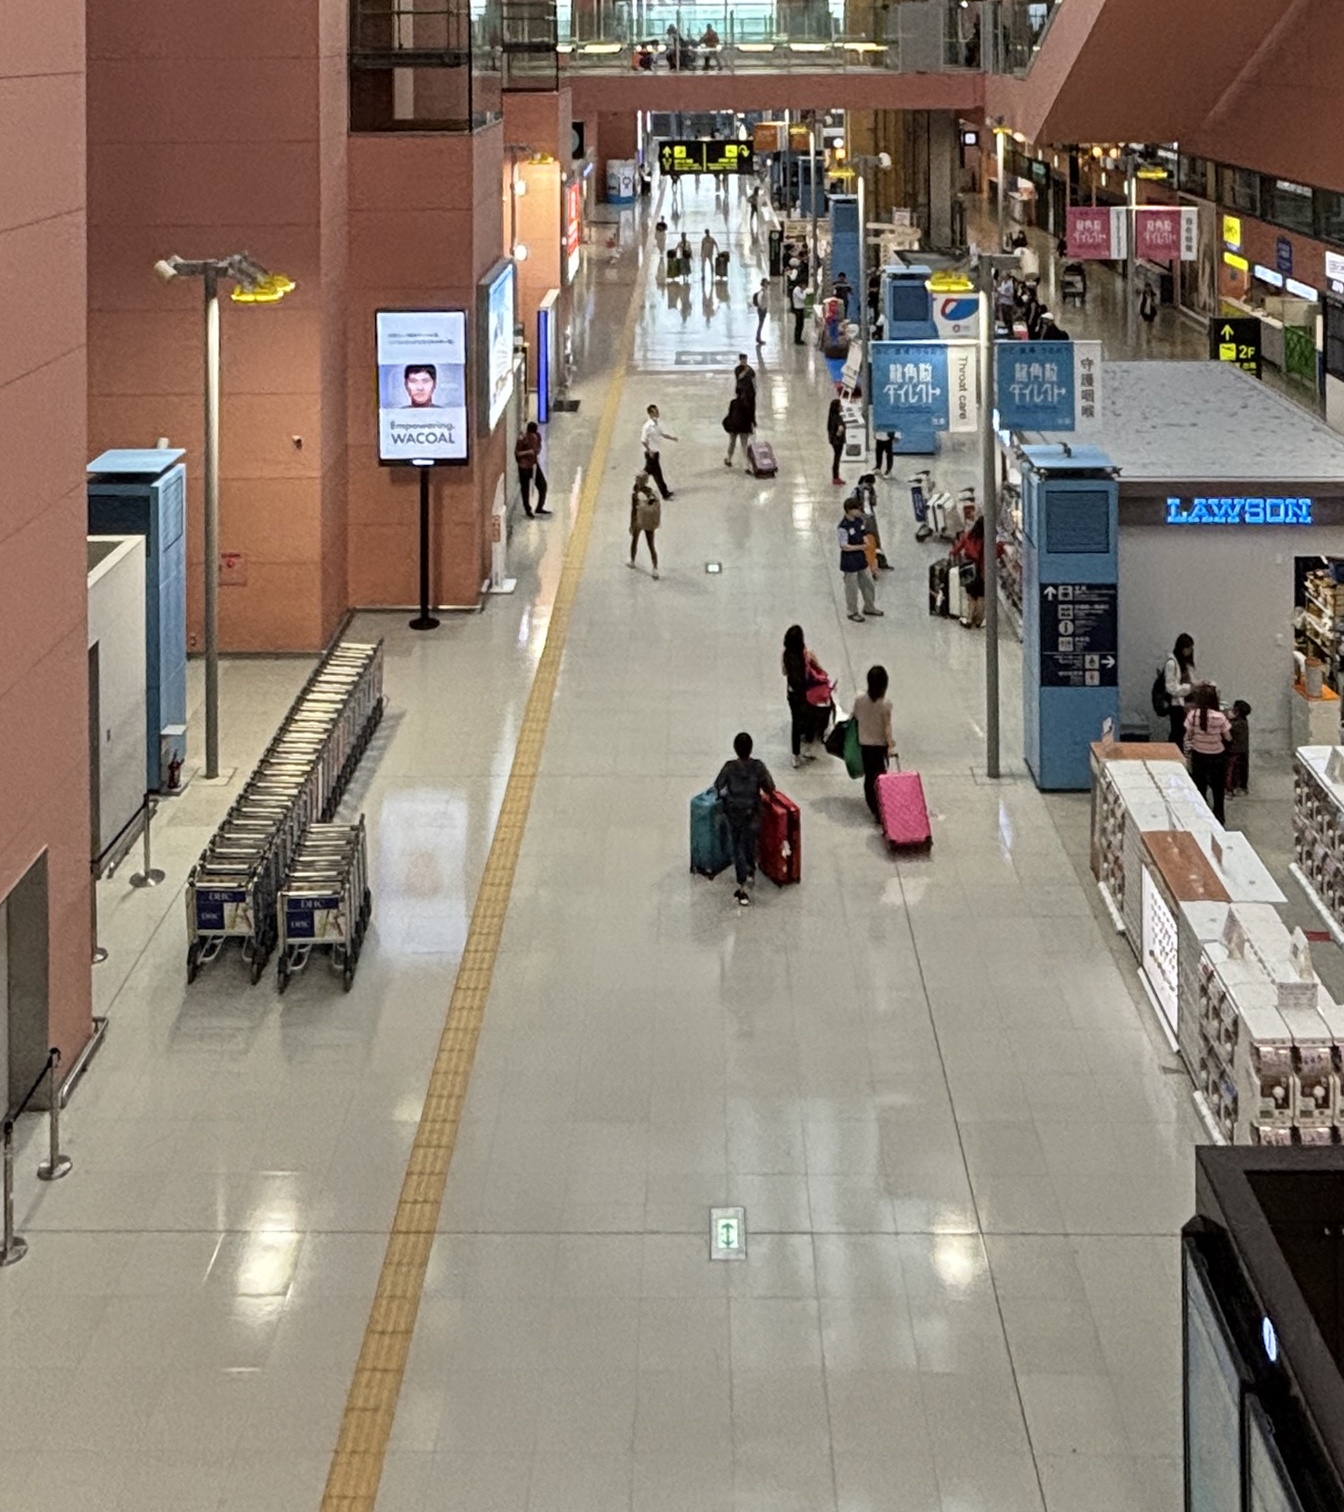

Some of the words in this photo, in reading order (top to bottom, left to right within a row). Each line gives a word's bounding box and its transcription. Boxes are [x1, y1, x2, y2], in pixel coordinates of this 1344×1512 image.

[1239, 345, 1256, 359] 2F
[957, 355, 968, 392] Throat
[958, 394, 968, 420] care
[390, 432, 456, 445] WACOAL
[1166, 497, 1313, 524] LAWSON
[208, 892, 234, 901] DHC
[300, 899, 325, 909] DHC
